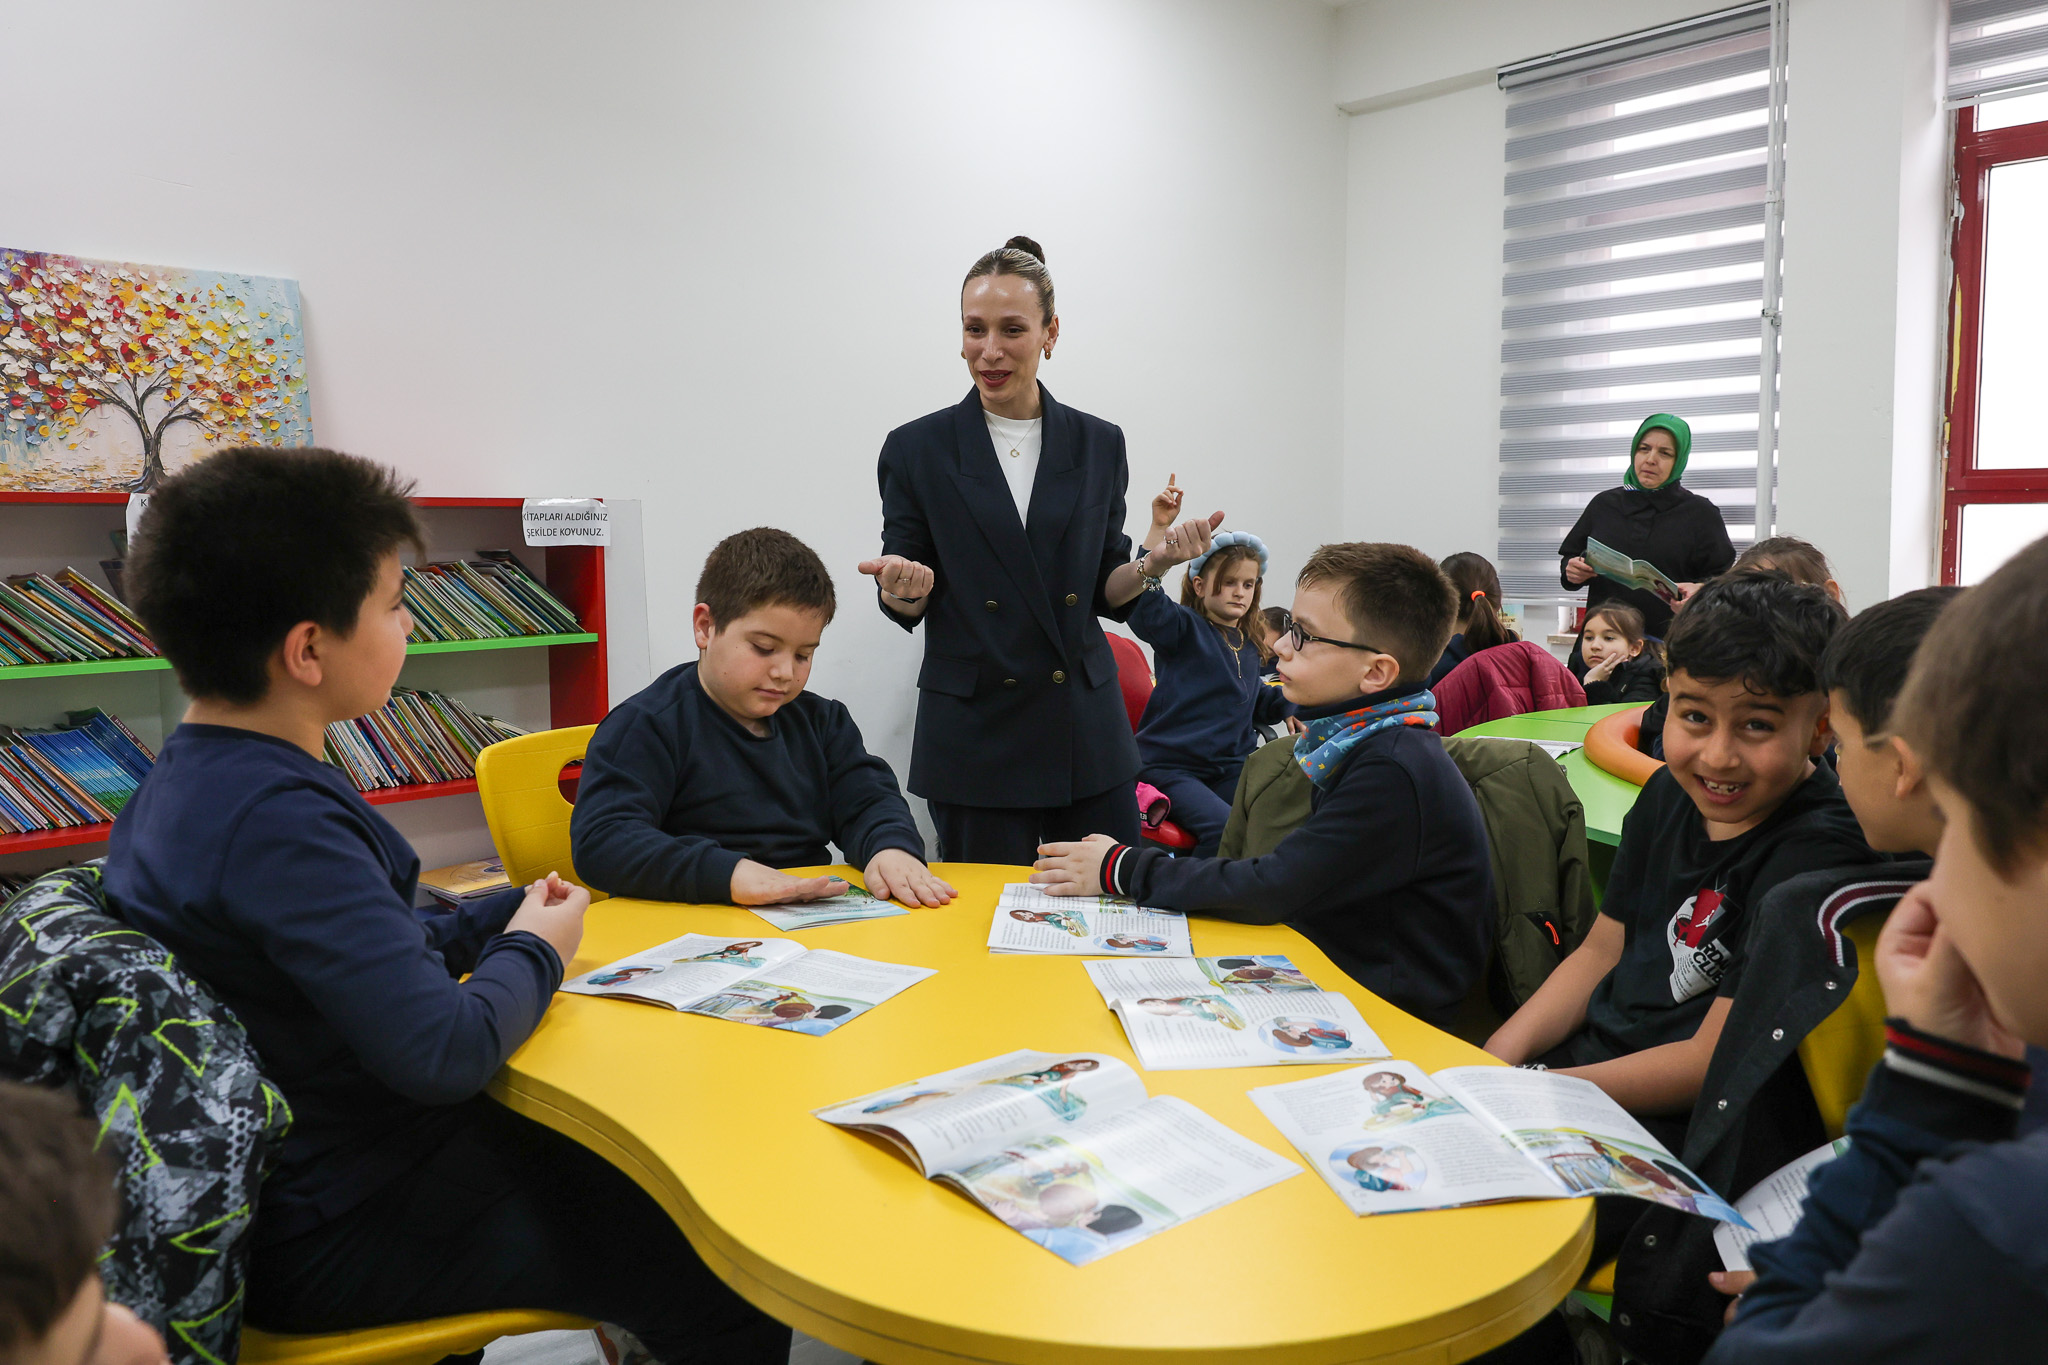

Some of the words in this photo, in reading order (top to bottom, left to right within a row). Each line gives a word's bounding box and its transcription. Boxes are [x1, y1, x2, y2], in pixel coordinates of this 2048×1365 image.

[523, 511, 563, 521] KİTAPLARI
[565, 511, 608, 521] ALDIĞINIZ
[526, 527, 557, 538] ŞEKİLDE
[560, 527, 604, 537] KOYUNUZ.
[1693, 951, 1724, 984] CLUB
